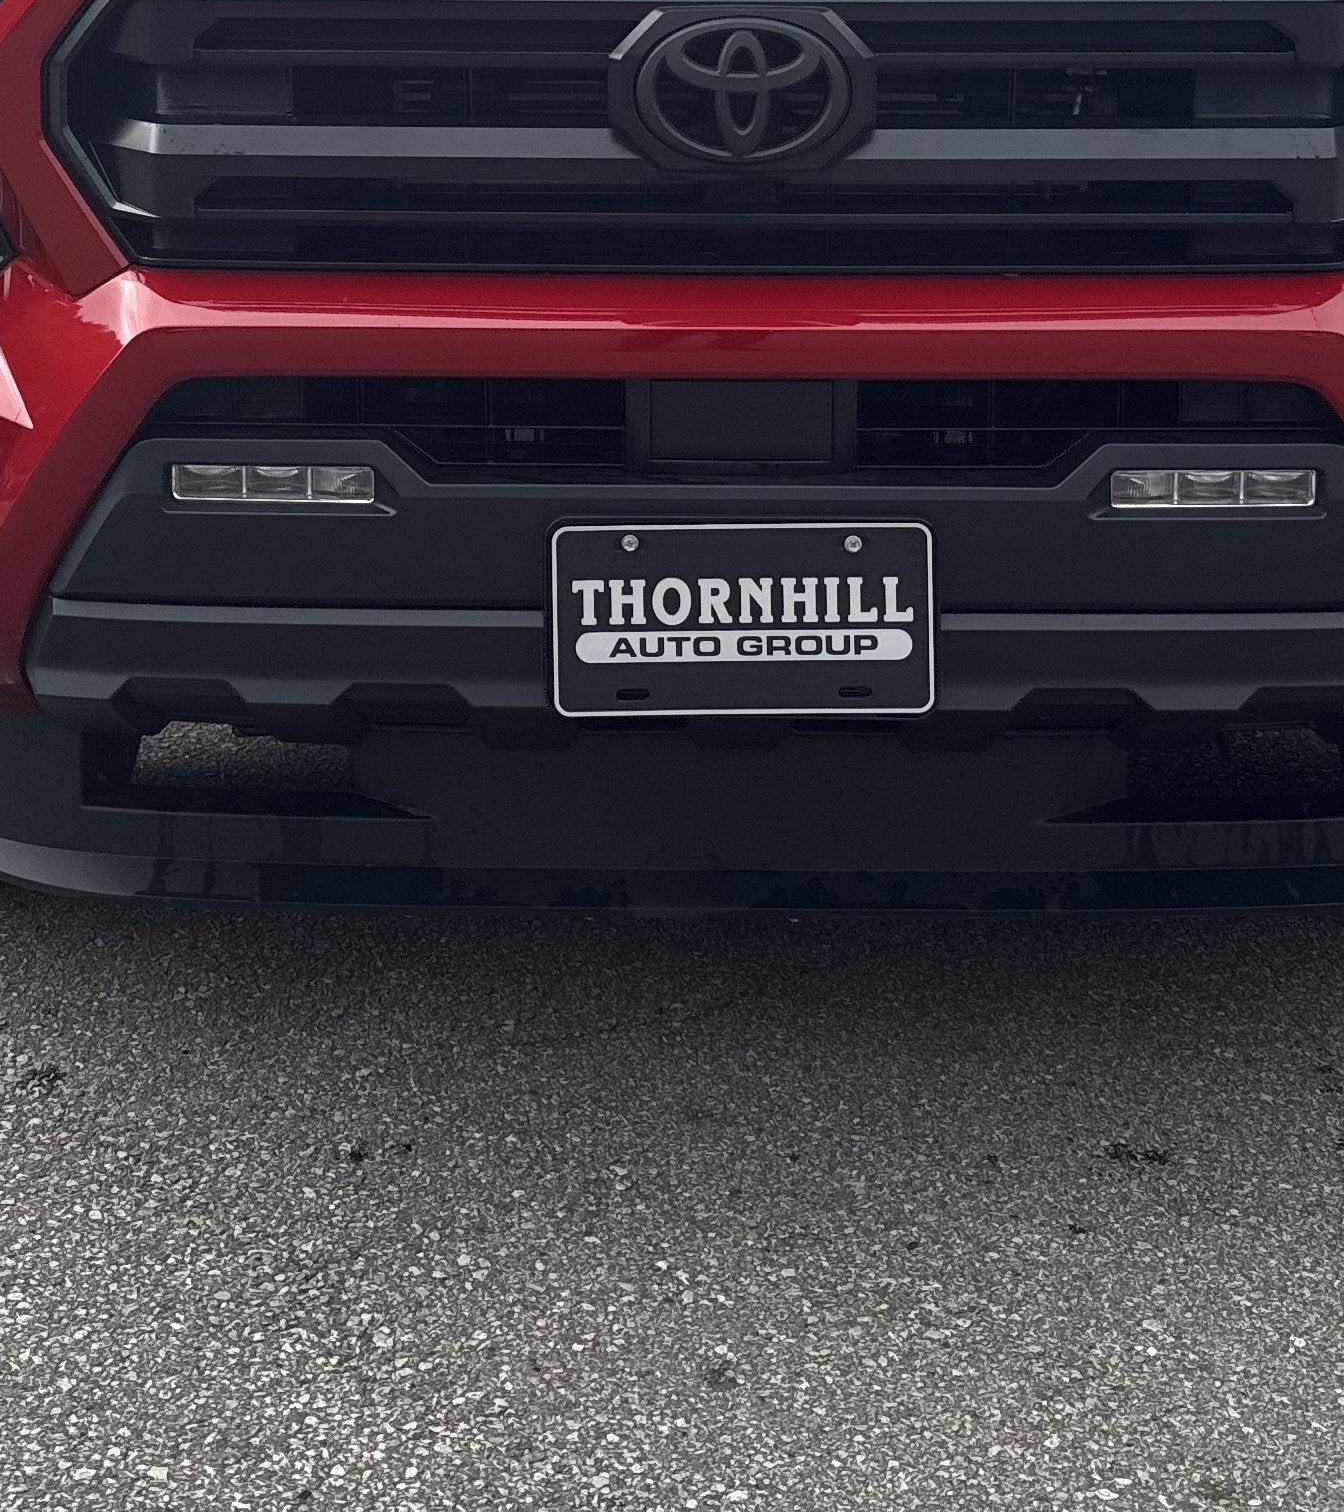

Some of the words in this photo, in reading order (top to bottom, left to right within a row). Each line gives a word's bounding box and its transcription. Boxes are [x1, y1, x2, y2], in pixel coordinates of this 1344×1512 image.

[571, 576, 914, 627] THORNHILL
[608, 636, 722, 658] AUTO
[736, 634, 879, 657] GROUP
